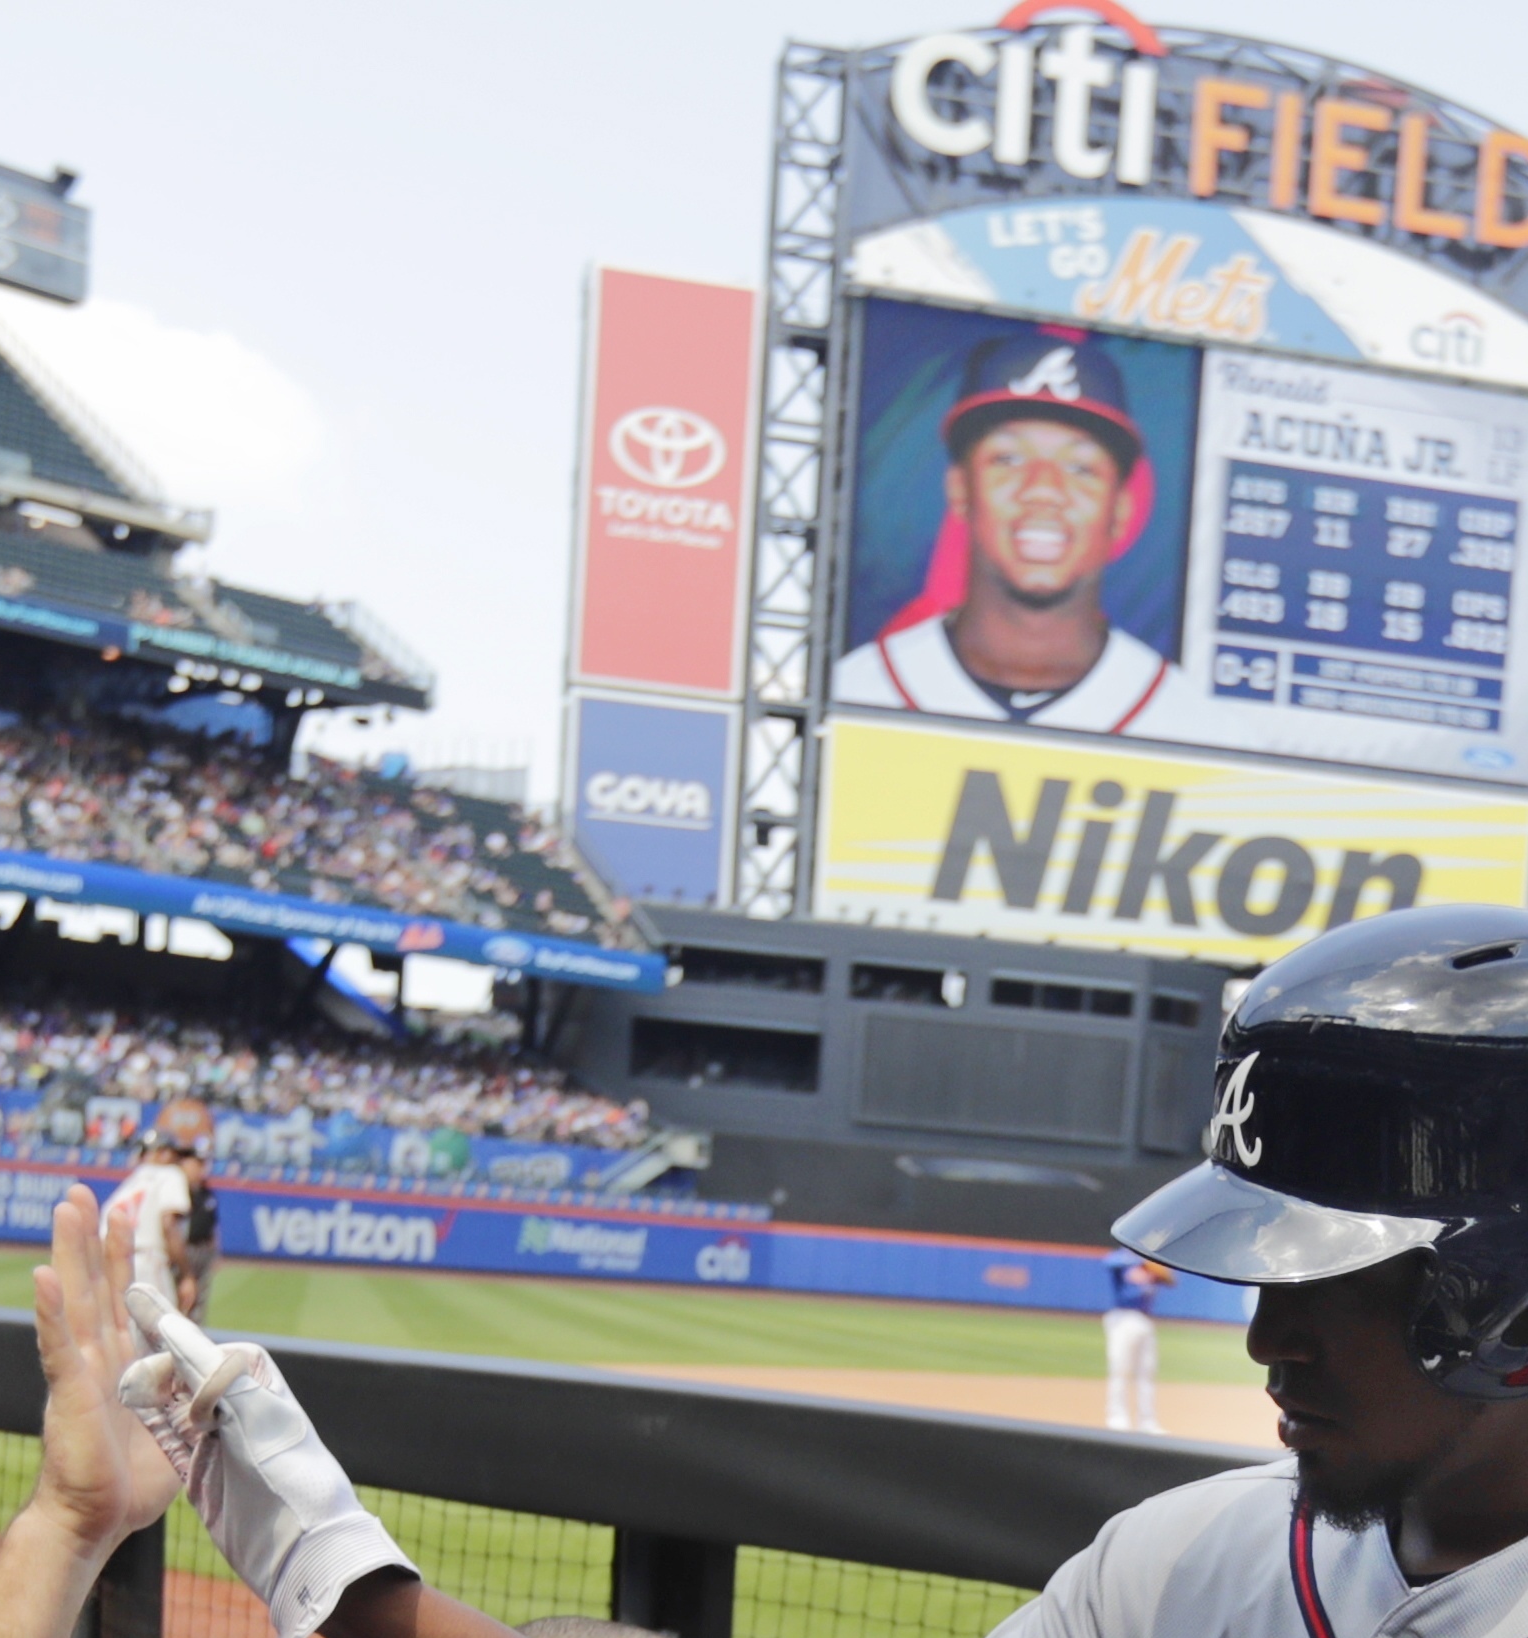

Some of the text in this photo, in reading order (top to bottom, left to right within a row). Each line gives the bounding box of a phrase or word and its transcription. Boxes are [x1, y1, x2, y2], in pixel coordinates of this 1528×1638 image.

[987, 206, 1107, 248] LET'S
[1049, 243, 1110, 279] GO
[1075, 227, 1274, 341] Mets
[1240, 408, 1466, 477] ACUÑA JR.
[596, 485, 735, 532] TOYOTA
[585, 771, 712, 820] GOYA
[929, 766, 1425, 940] Nikon
[252, 1199, 437, 1263] verizon
[552, 1221, 647, 1258] National
[695, 1240, 751, 1281] citi
